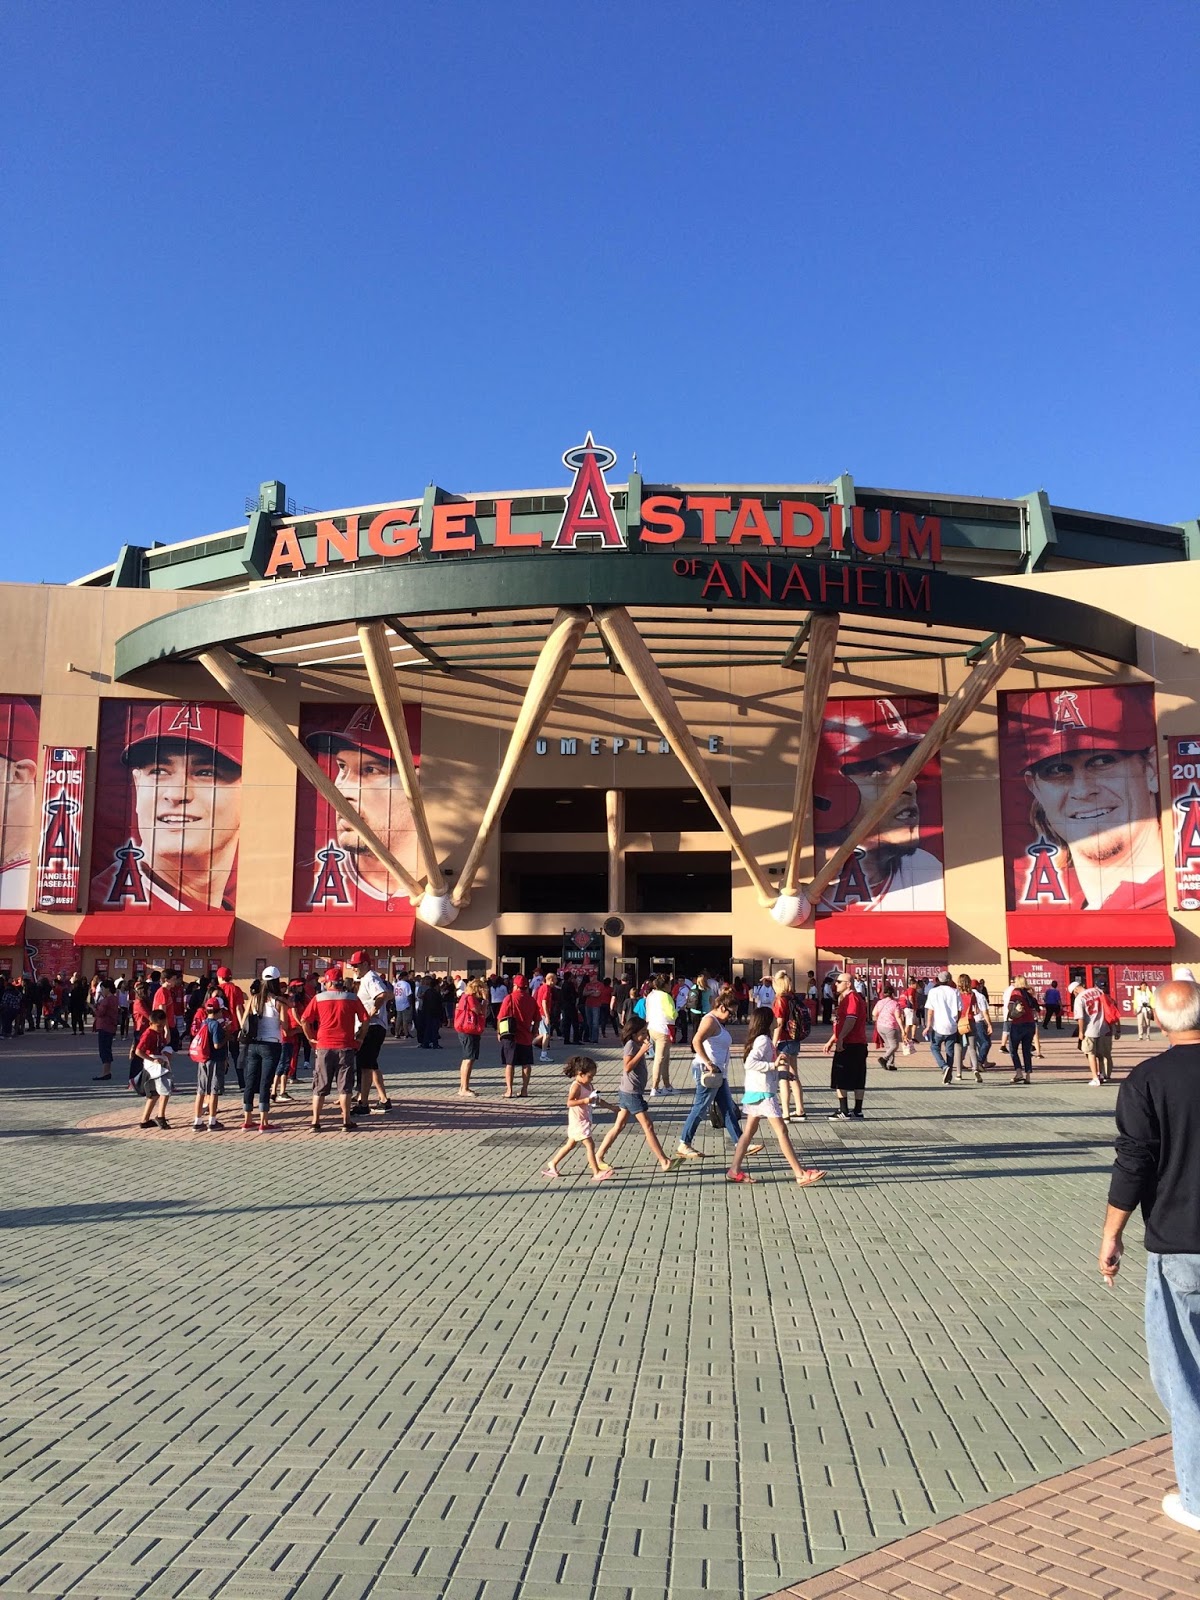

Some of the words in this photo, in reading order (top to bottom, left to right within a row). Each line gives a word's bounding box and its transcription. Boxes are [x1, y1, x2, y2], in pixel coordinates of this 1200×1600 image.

[264, 499, 543, 578] ANGEL
[638, 494, 943, 564] STADIUM
[672, 557, 702, 577] OF
[701, 559, 932, 613] ANAHEIM
[45, 769, 82, 784] 2015
[38, 880, 77, 888] BASEBALL
[1122, 965, 1165, 982] ANGELS
